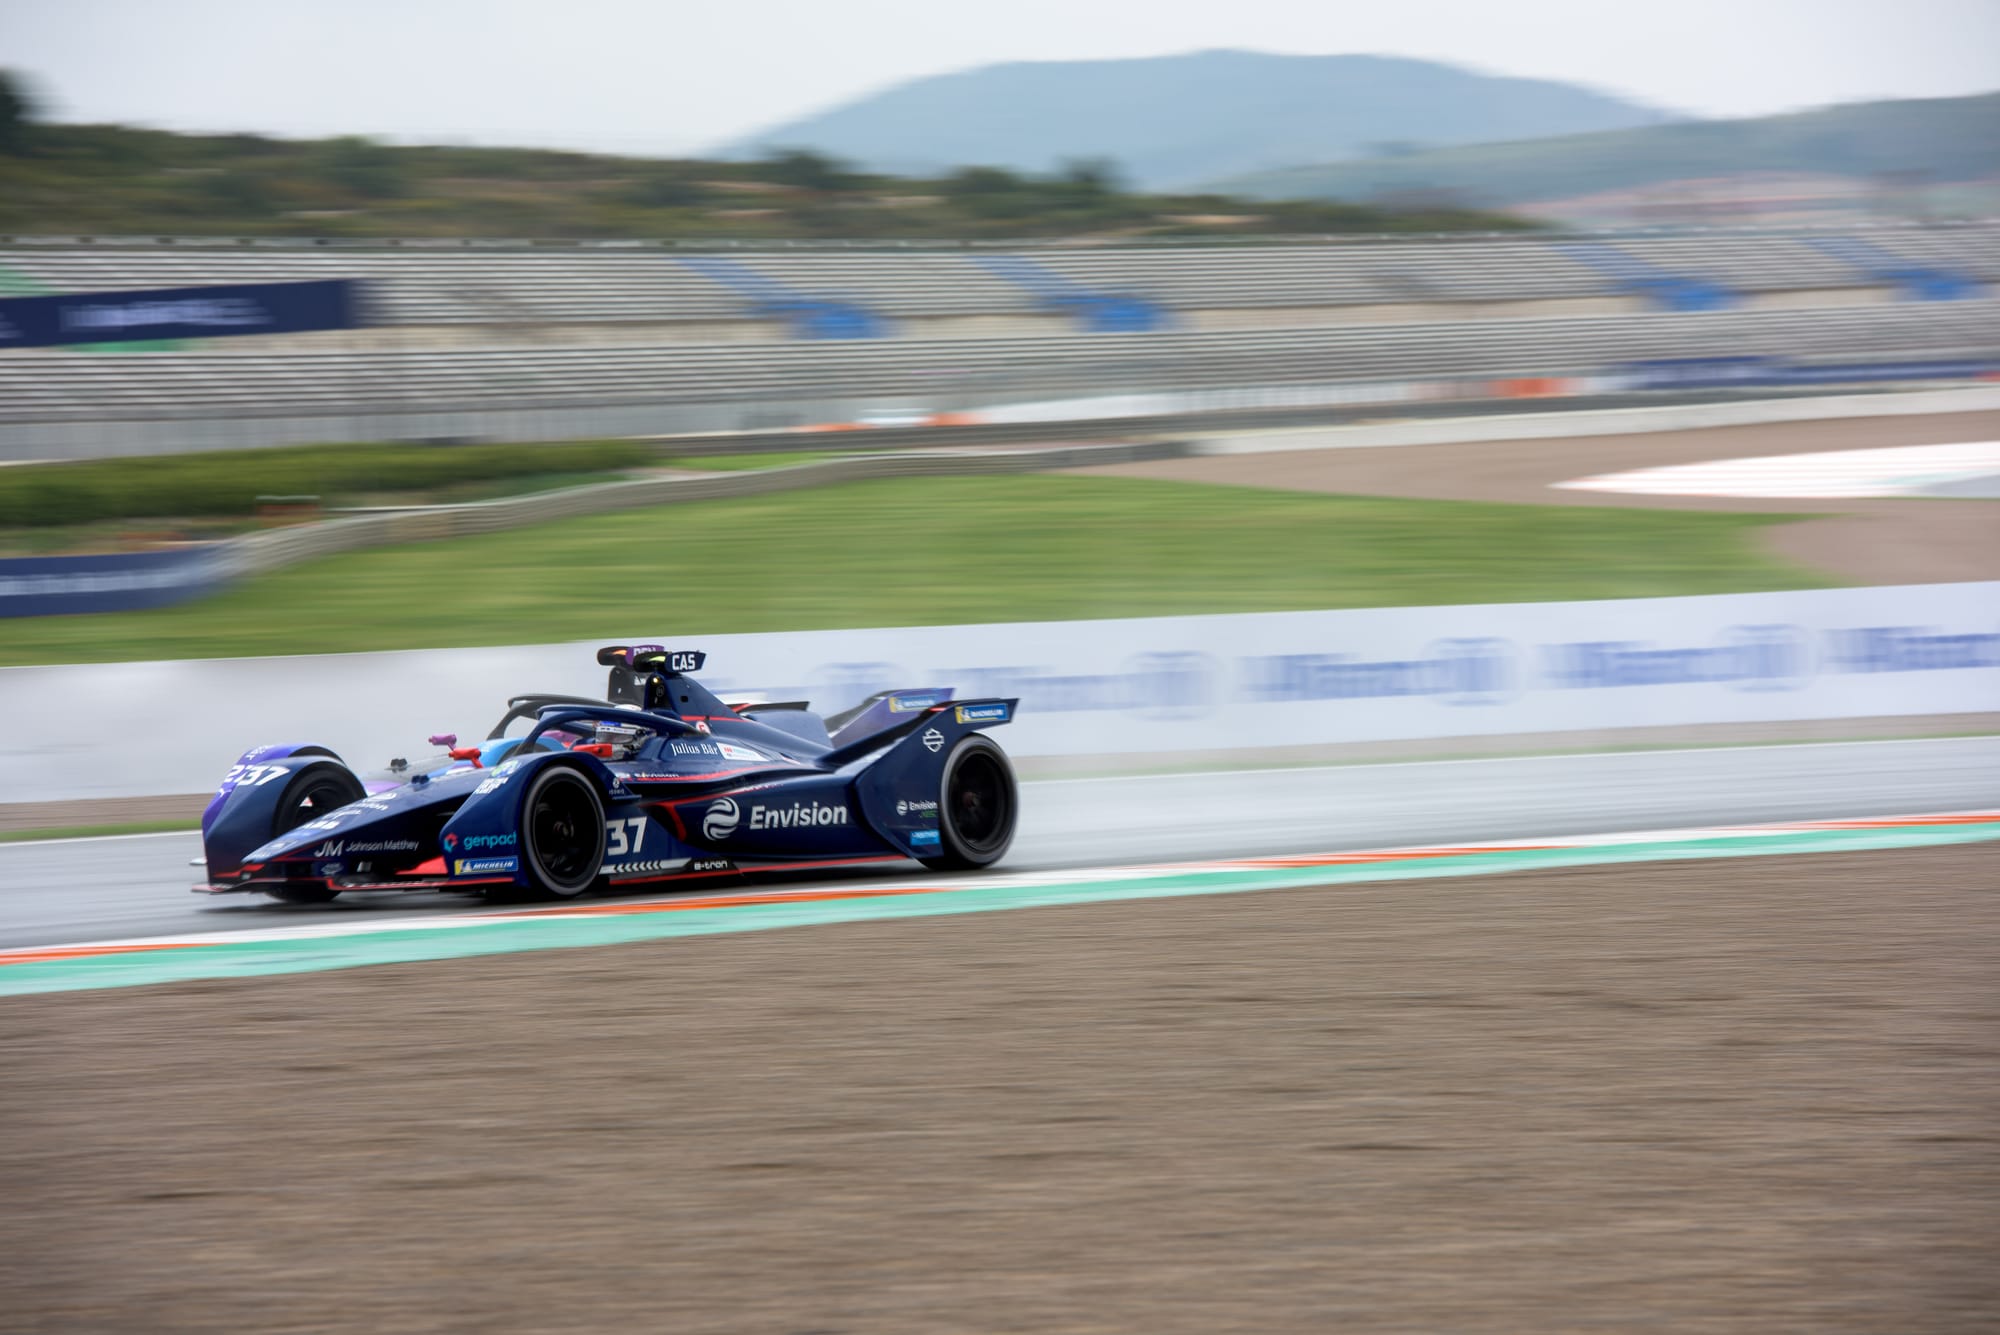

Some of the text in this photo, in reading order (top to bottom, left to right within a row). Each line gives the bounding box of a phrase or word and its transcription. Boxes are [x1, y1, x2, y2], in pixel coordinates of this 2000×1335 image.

[672, 654, 696, 670] CAS
[671, 743, 700, 756] Julius
[700, 743, 718, 756] Bär
[237, 765, 291, 786] 37
[908, 800, 938, 811] Envision
[749, 801, 848, 830] Envision
[463, 830, 517, 851] genpact
[606, 816, 647, 856] 37
[314, 840, 344, 858] JM
[345, 840, 420, 853] Johnson Matthey
[472, 861, 515, 870] MICHELIN
